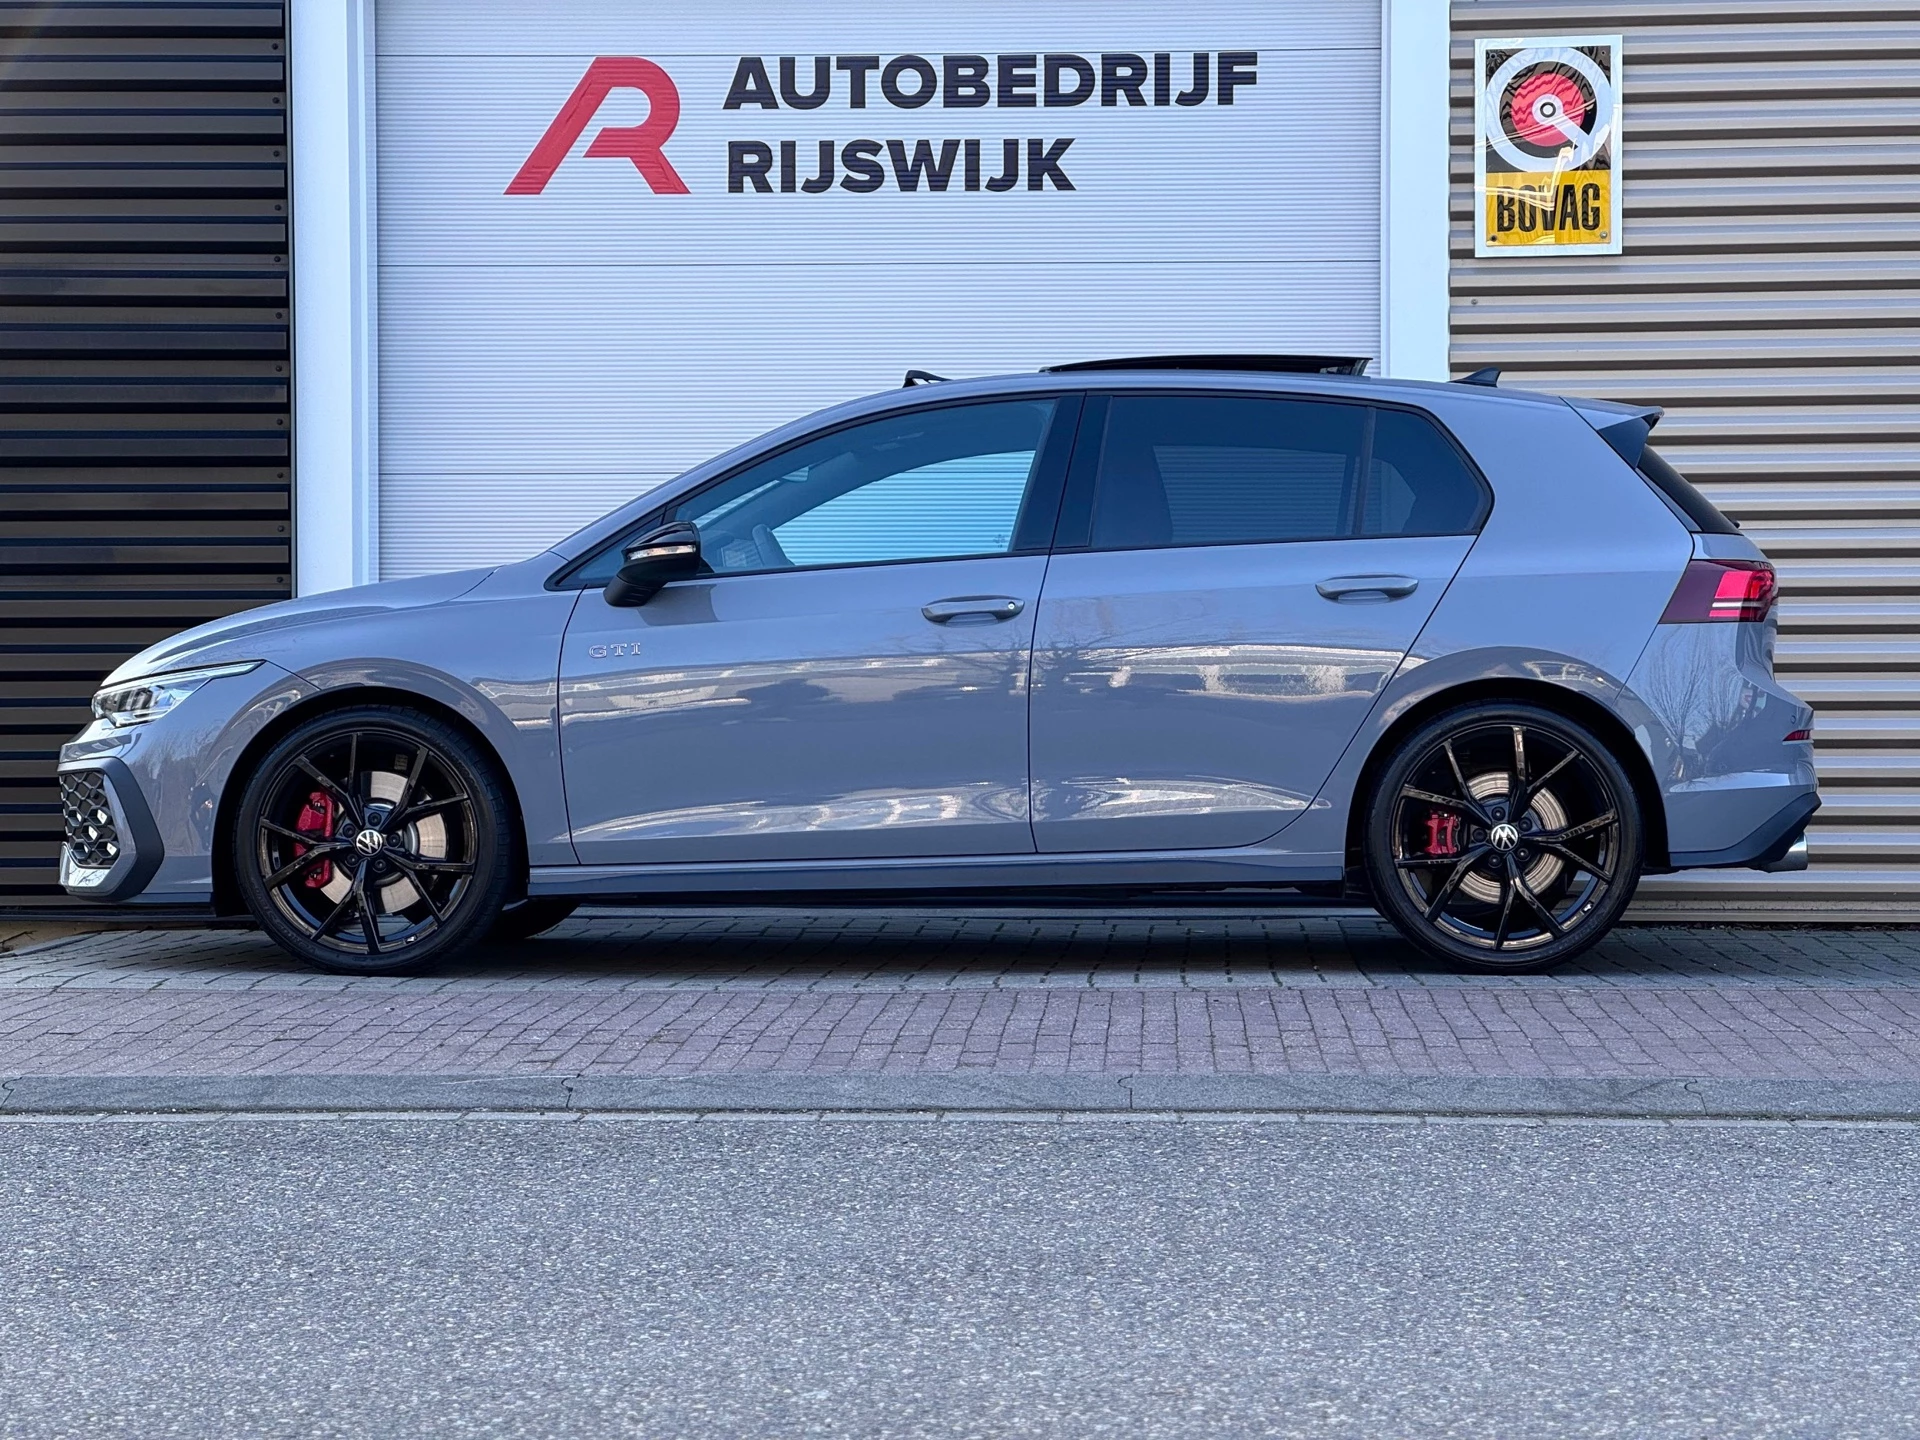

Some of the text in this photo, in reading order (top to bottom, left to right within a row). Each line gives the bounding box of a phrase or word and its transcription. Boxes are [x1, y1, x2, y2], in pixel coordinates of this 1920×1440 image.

[723, 52, 1258, 111] AUTOBEDRIJF
[728, 138, 1077, 194] RIJSWIJK
[1496, 182, 1601, 233] BOVAG
[588, 642, 641, 659] GTI
